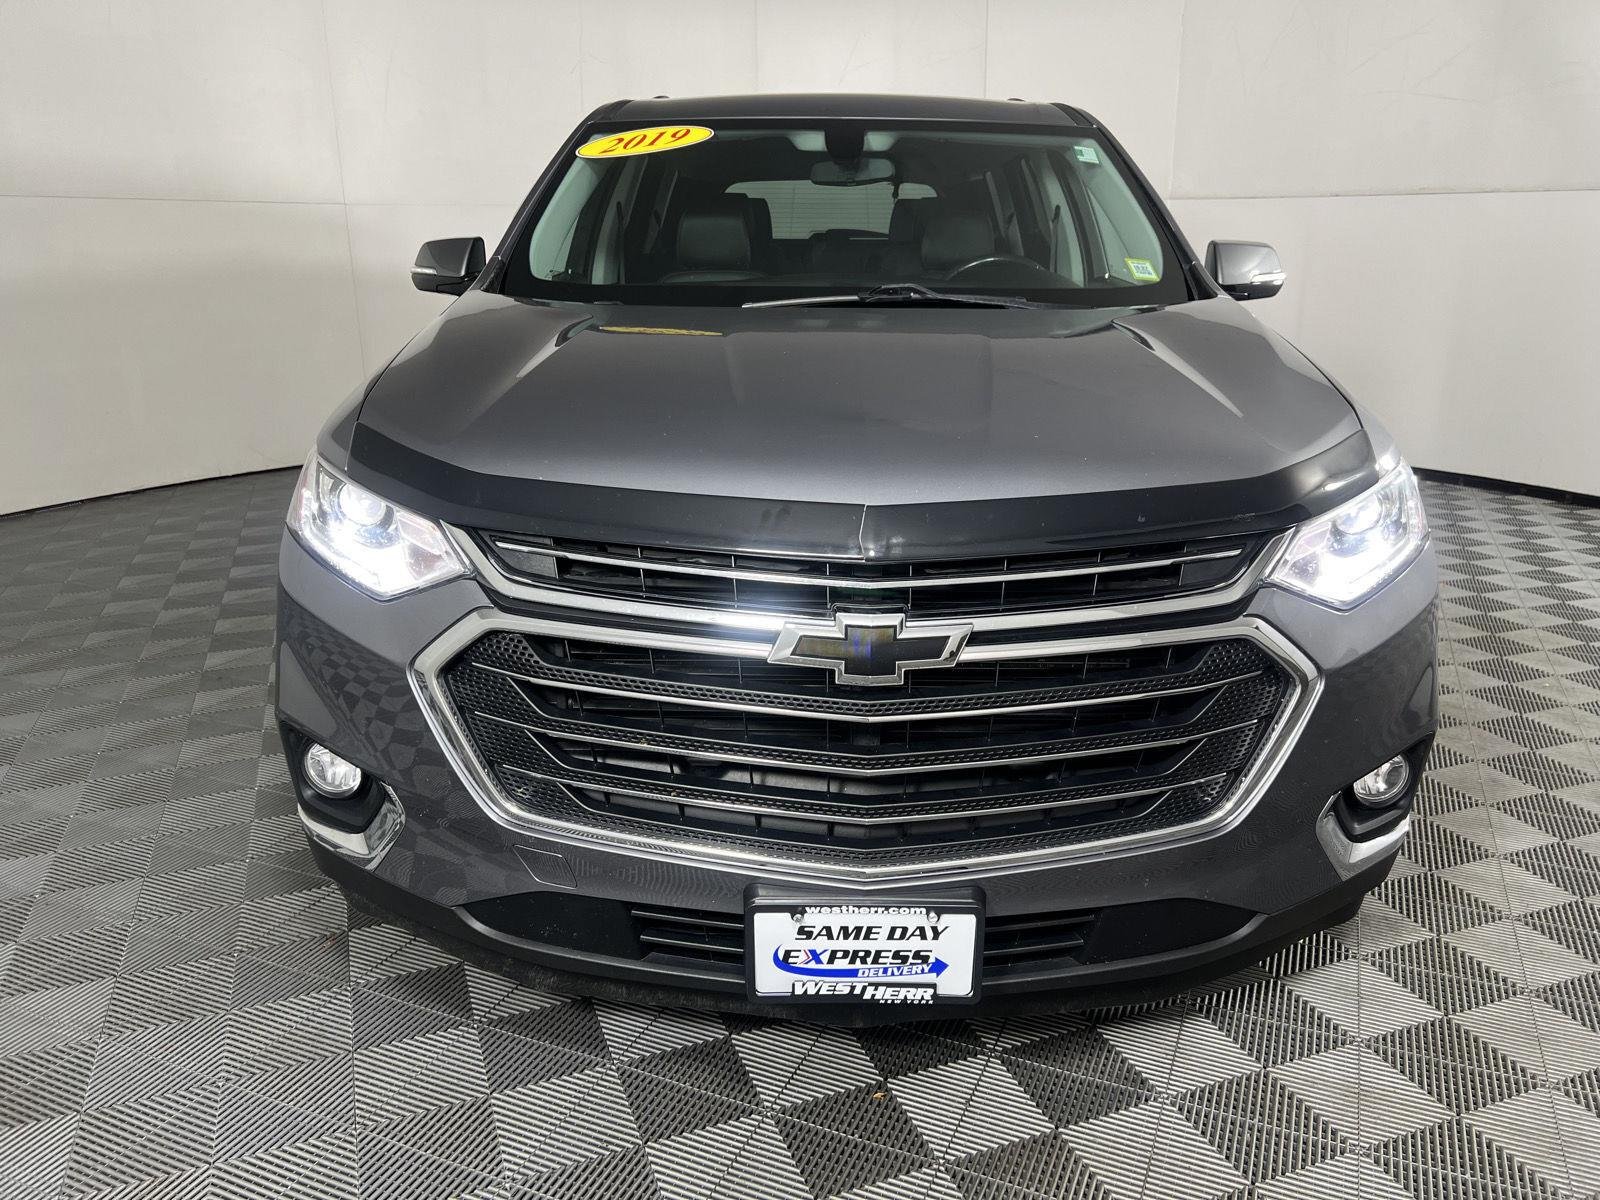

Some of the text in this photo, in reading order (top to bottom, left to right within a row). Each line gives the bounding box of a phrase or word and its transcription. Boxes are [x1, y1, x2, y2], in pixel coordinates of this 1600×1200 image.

[598, 128, 691, 154] 2019
[805, 905, 927, 915] westherr.com
[795, 926, 950, 941] SAME DAY
[782, 949, 933, 965] EXPRESS
[858, 965, 932, 977] DELIVERY
